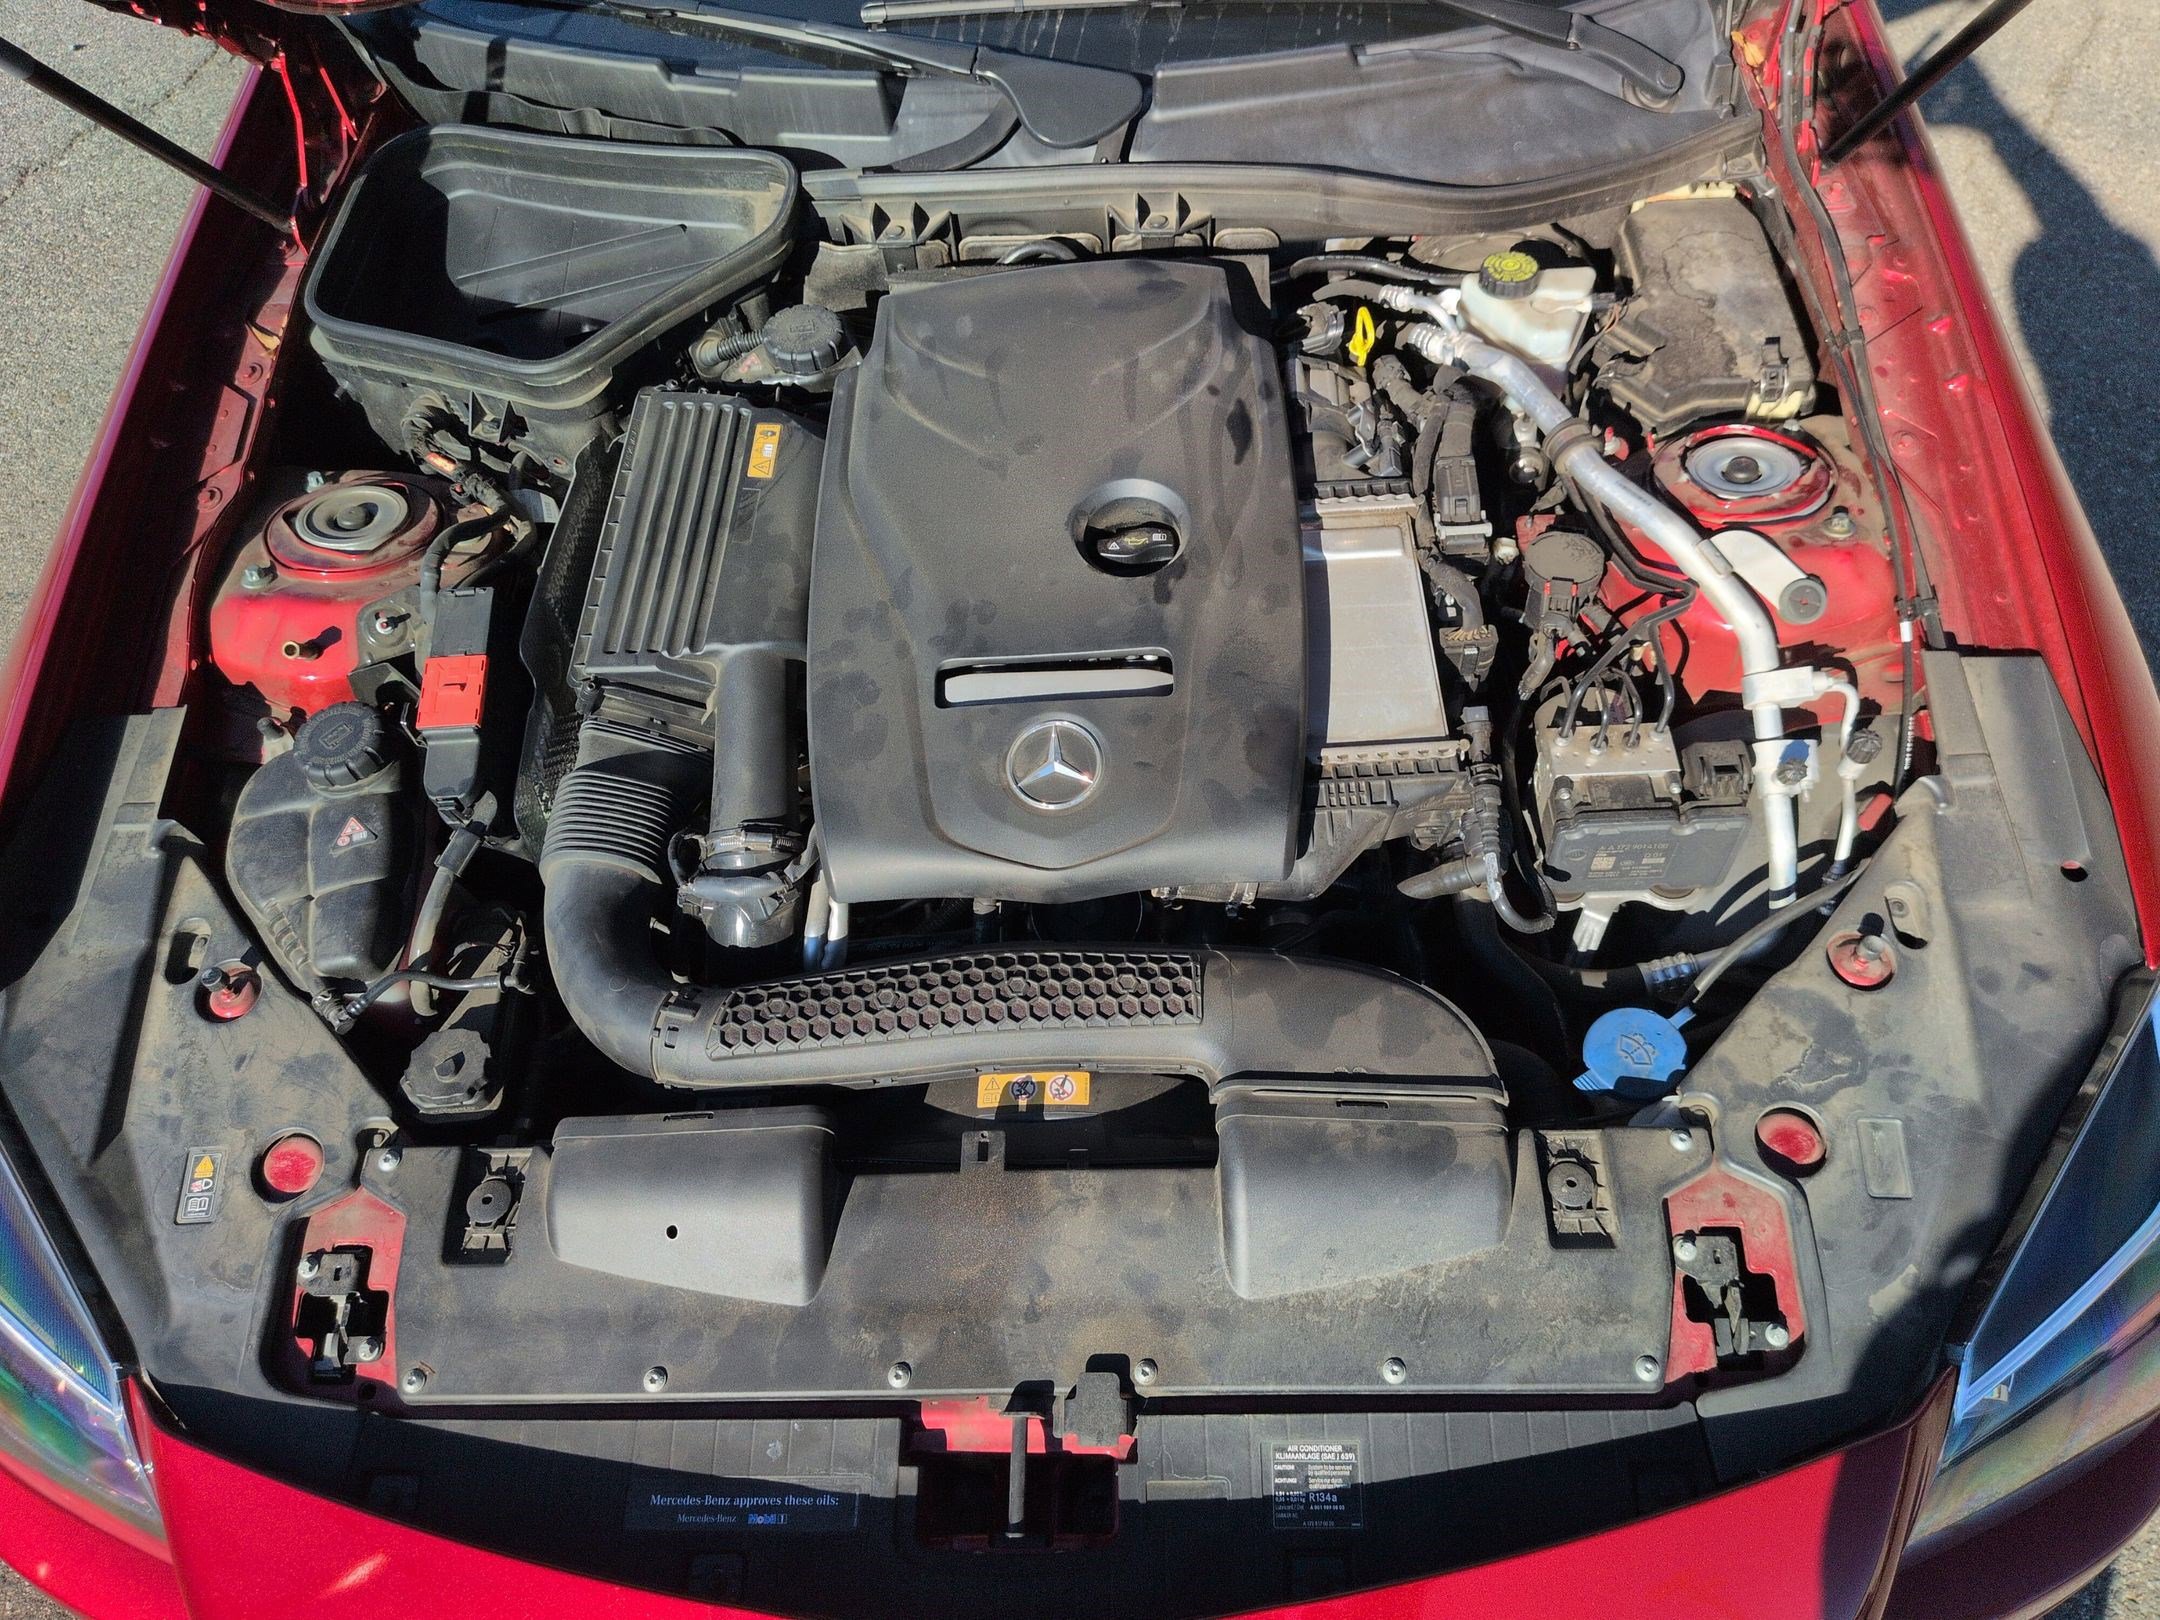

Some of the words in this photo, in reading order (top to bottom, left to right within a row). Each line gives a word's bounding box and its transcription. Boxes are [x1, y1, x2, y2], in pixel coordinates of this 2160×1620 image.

[1287, 1444, 1299, 1452] AIR
[1299, 1444, 1343, 1452] CONDITIONER
[1275, 1452, 1320, 1460] KLIMAANLAGE
[1321, 1452, 1336, 1461] (SAE
[1340, 1452, 1355, 1461] 639)
[649, 1494, 731, 1506] Mercedes-Benz
[733, 1495, 782, 1508] approves
[784, 1494, 814, 1506] these
[816, 1494, 840, 1506] oils:
[1309, 1492, 1338, 1502] R134a
[677, 1513, 737, 1523] Mercedes-Benz
